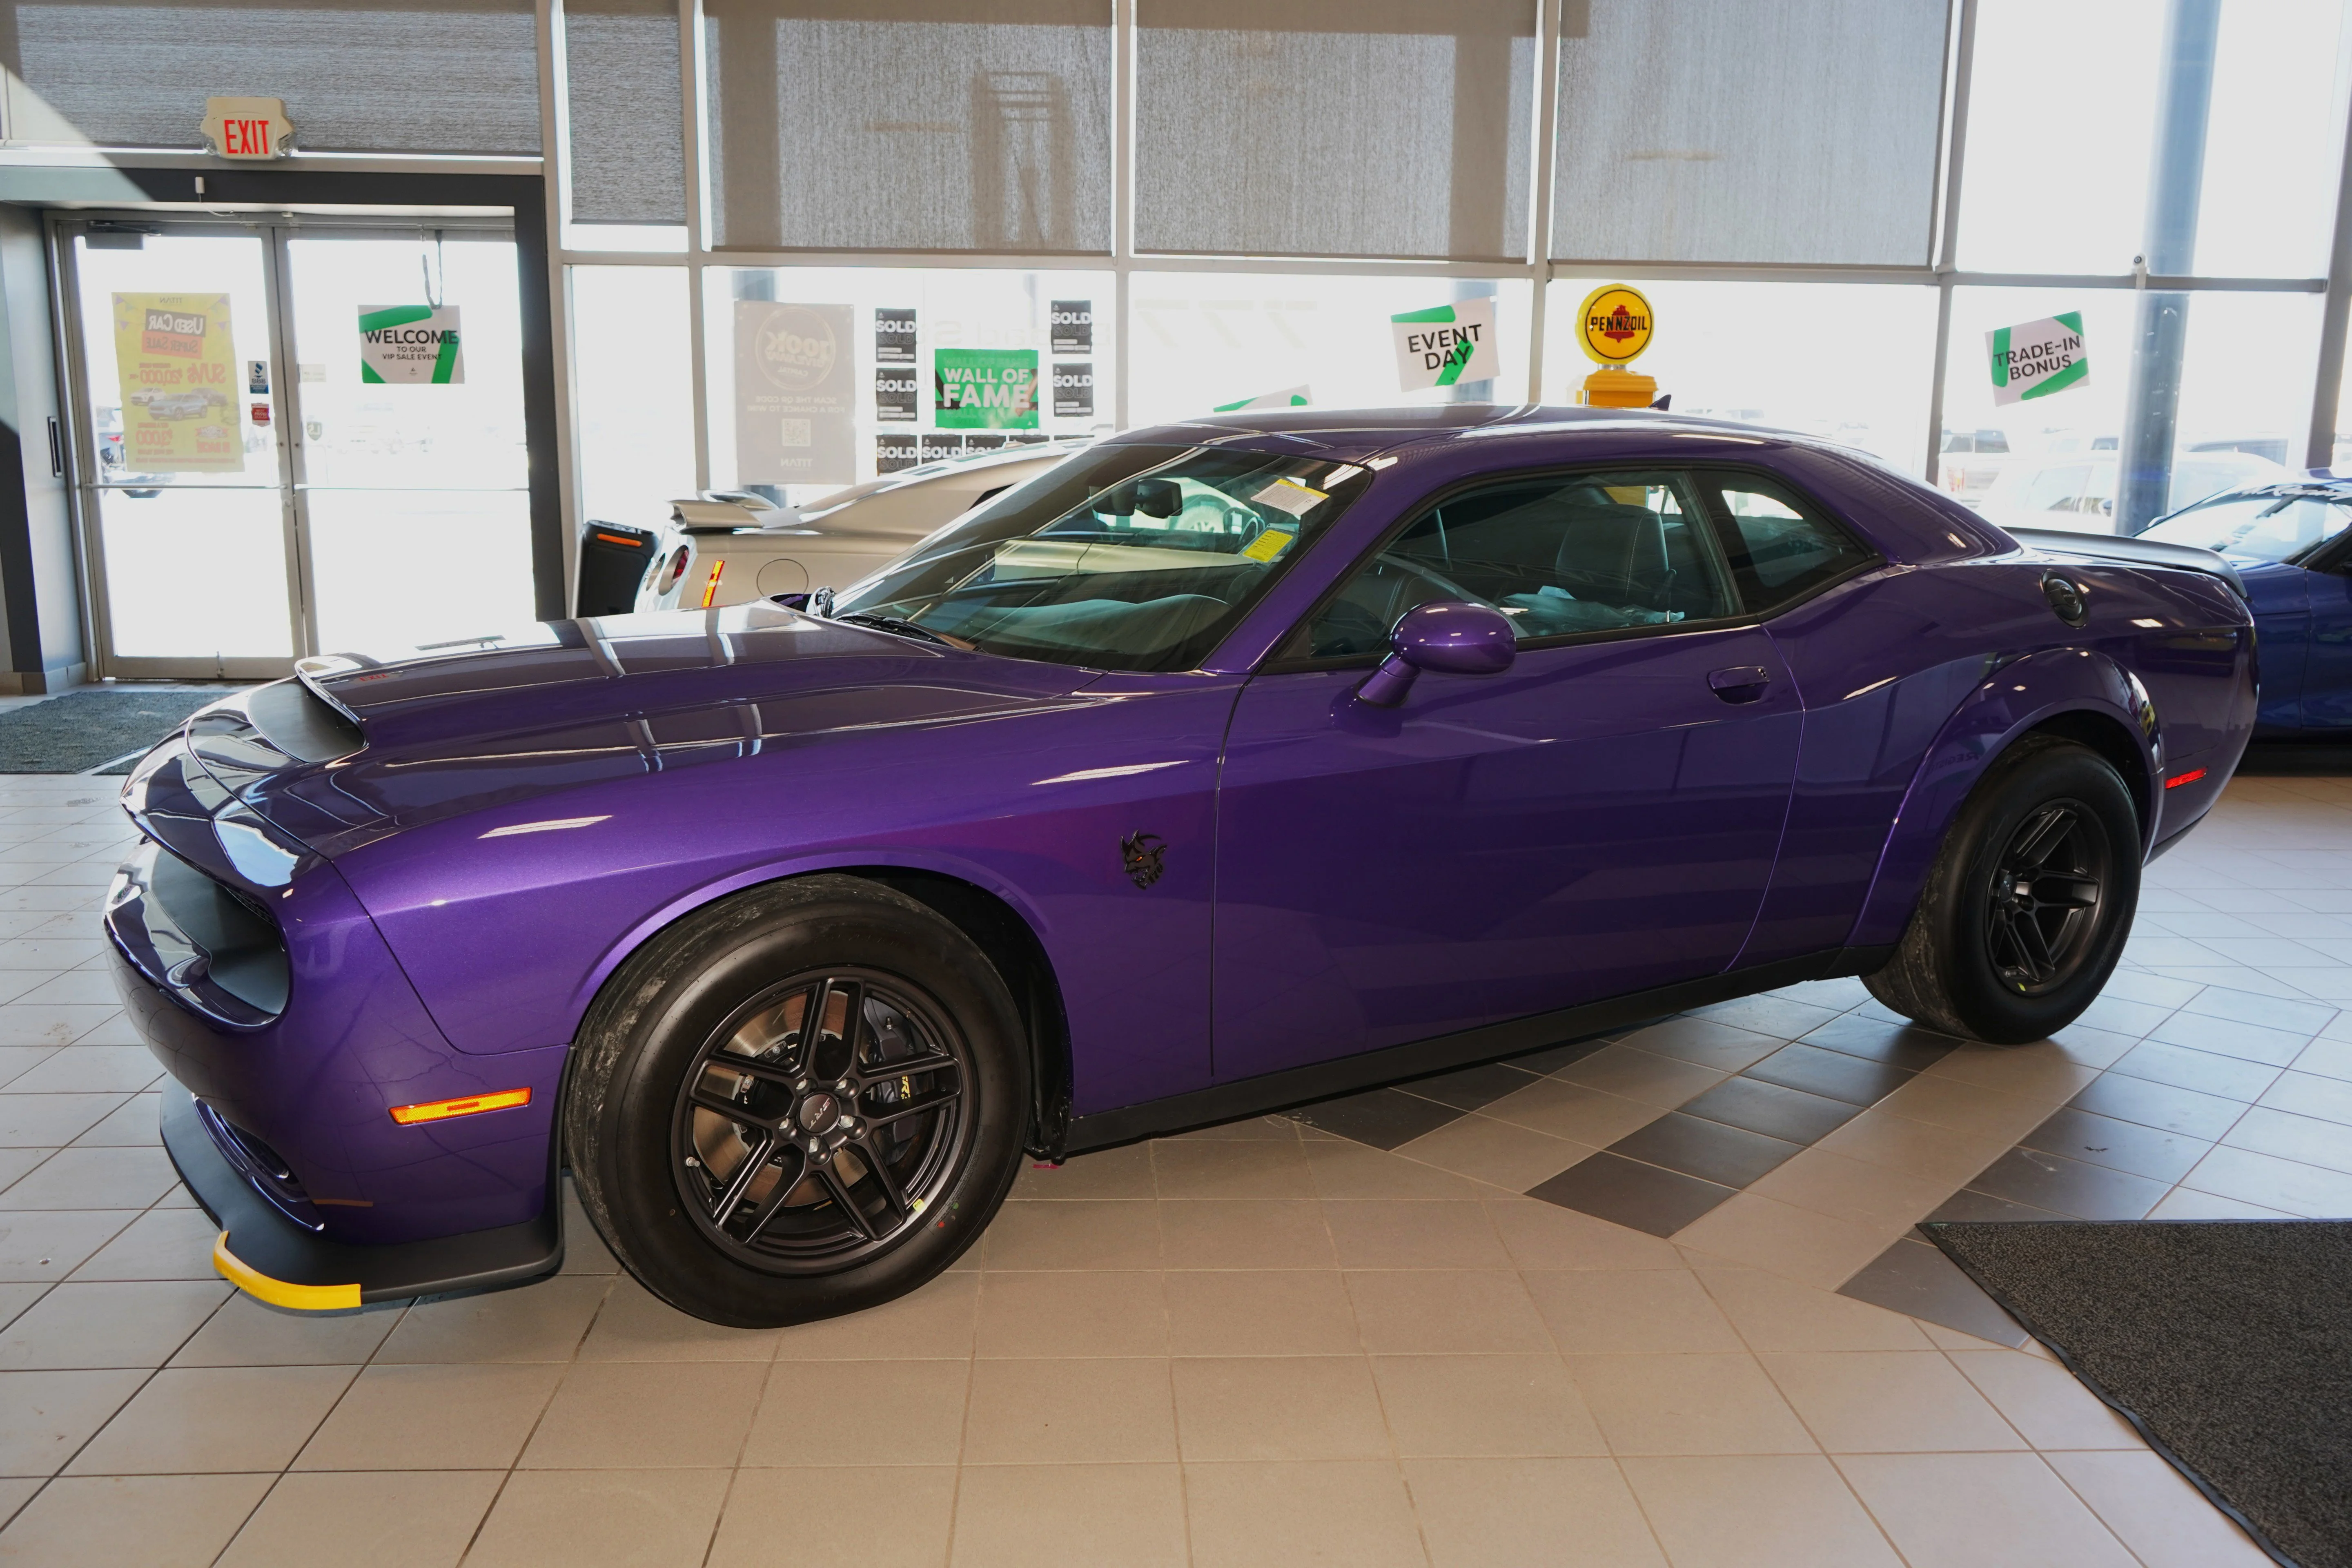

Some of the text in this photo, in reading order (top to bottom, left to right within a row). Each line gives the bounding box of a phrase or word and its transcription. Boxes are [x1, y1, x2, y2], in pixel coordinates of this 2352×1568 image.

[224, 120, 269, 155] EXIT
[1051, 312, 1091, 325] SOLD
[1590, 316, 1647, 331] PENNZOIL
[875, 321, 916, 333] SOLD
[364, 330, 458, 345] WELCOME
[1409, 324, 1482, 354] EVENT
[1994, 335, 2080, 367] TRADE-IN
[1425, 347, 1472, 371] DAY
[2010, 354, 2072, 381] BONUS
[944, 368, 1029, 383] WALL OF
[1053, 374, 1093, 387] SOLD
[876, 380, 916, 392] SOLD
[943, 384, 1030, 408] FAME
[877, 446, 917, 459] SOLD
[922, 445, 962, 458] SOLD
[808, 1098, 831, 1130] SRT
